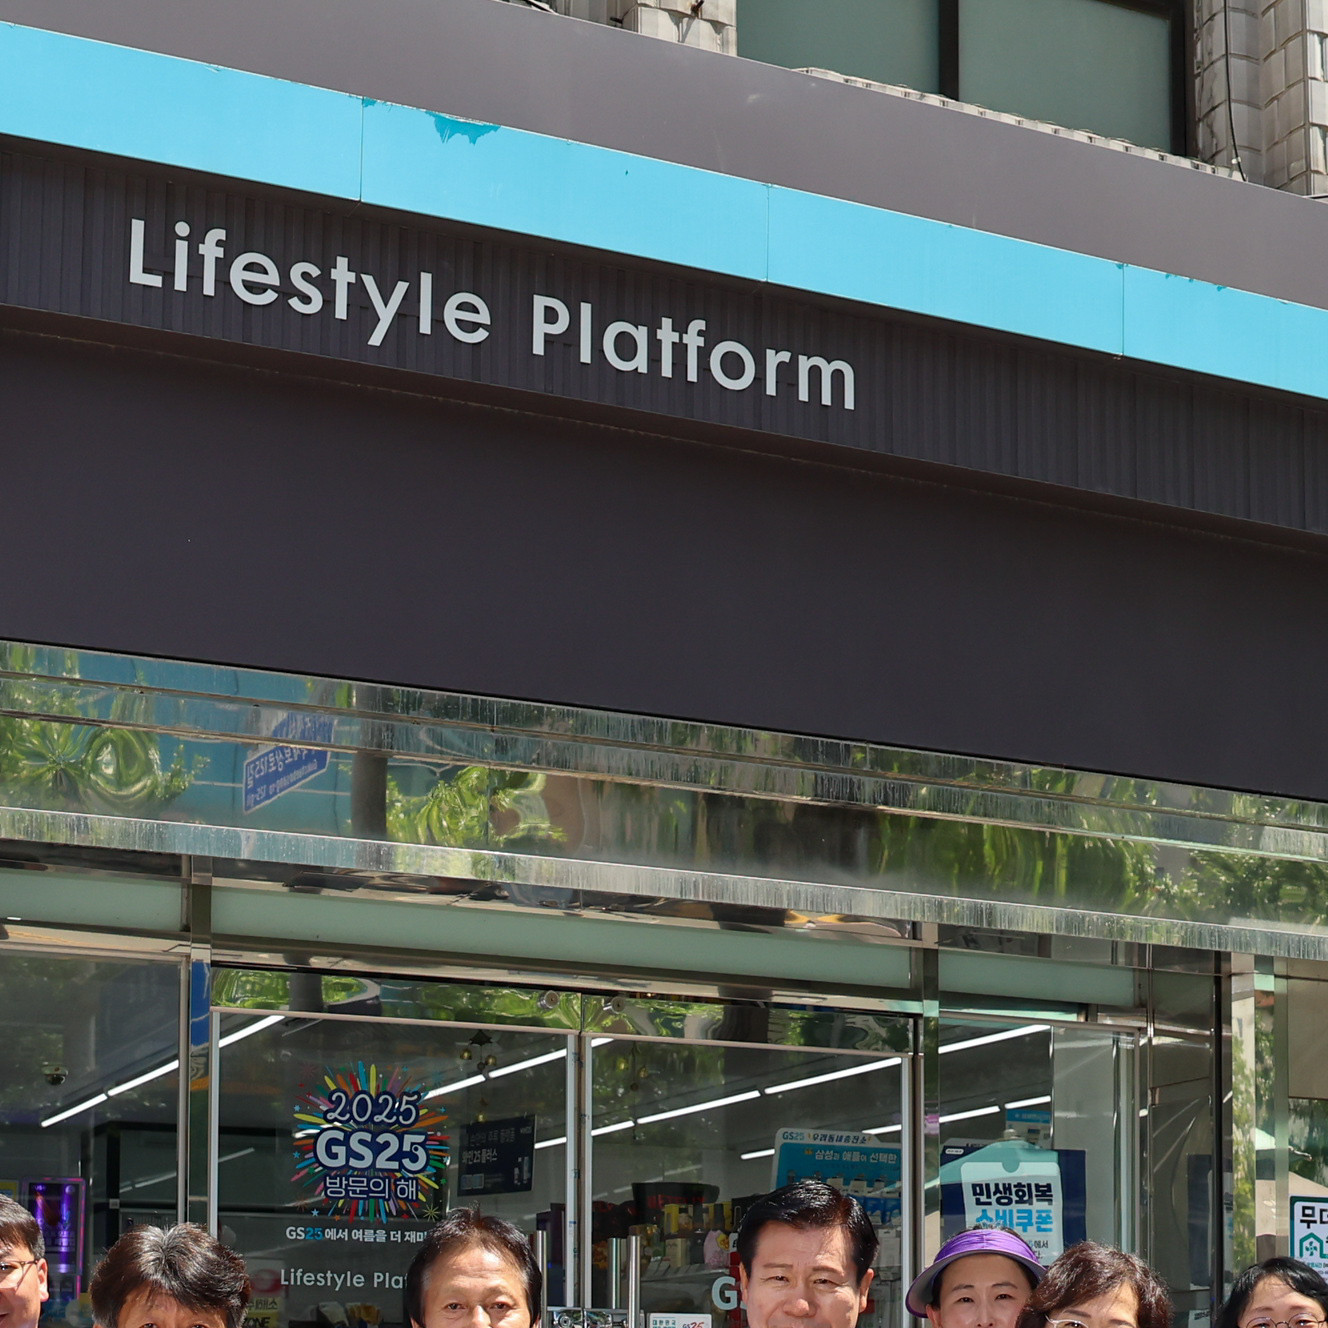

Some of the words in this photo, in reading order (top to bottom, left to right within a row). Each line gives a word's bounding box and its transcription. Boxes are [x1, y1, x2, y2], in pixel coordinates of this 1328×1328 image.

[129, 217, 492, 347] Lifestyle
[532, 294, 856, 411] Platform
[326, 1091, 418, 1125] 2025
[782, 1131, 805, 1141] GS25
[315, 1129, 428, 1171] GS25
[325, 1176, 390, 1200] 방문의
[396, 1177, 419, 1201] 해
[971, 1182, 1054, 1207] 민생회복
[351, 1228, 387, 1242] 여름을
[389, 1229, 402, 1243] 더
[279, 1268, 365, 1291] Lifestyle
